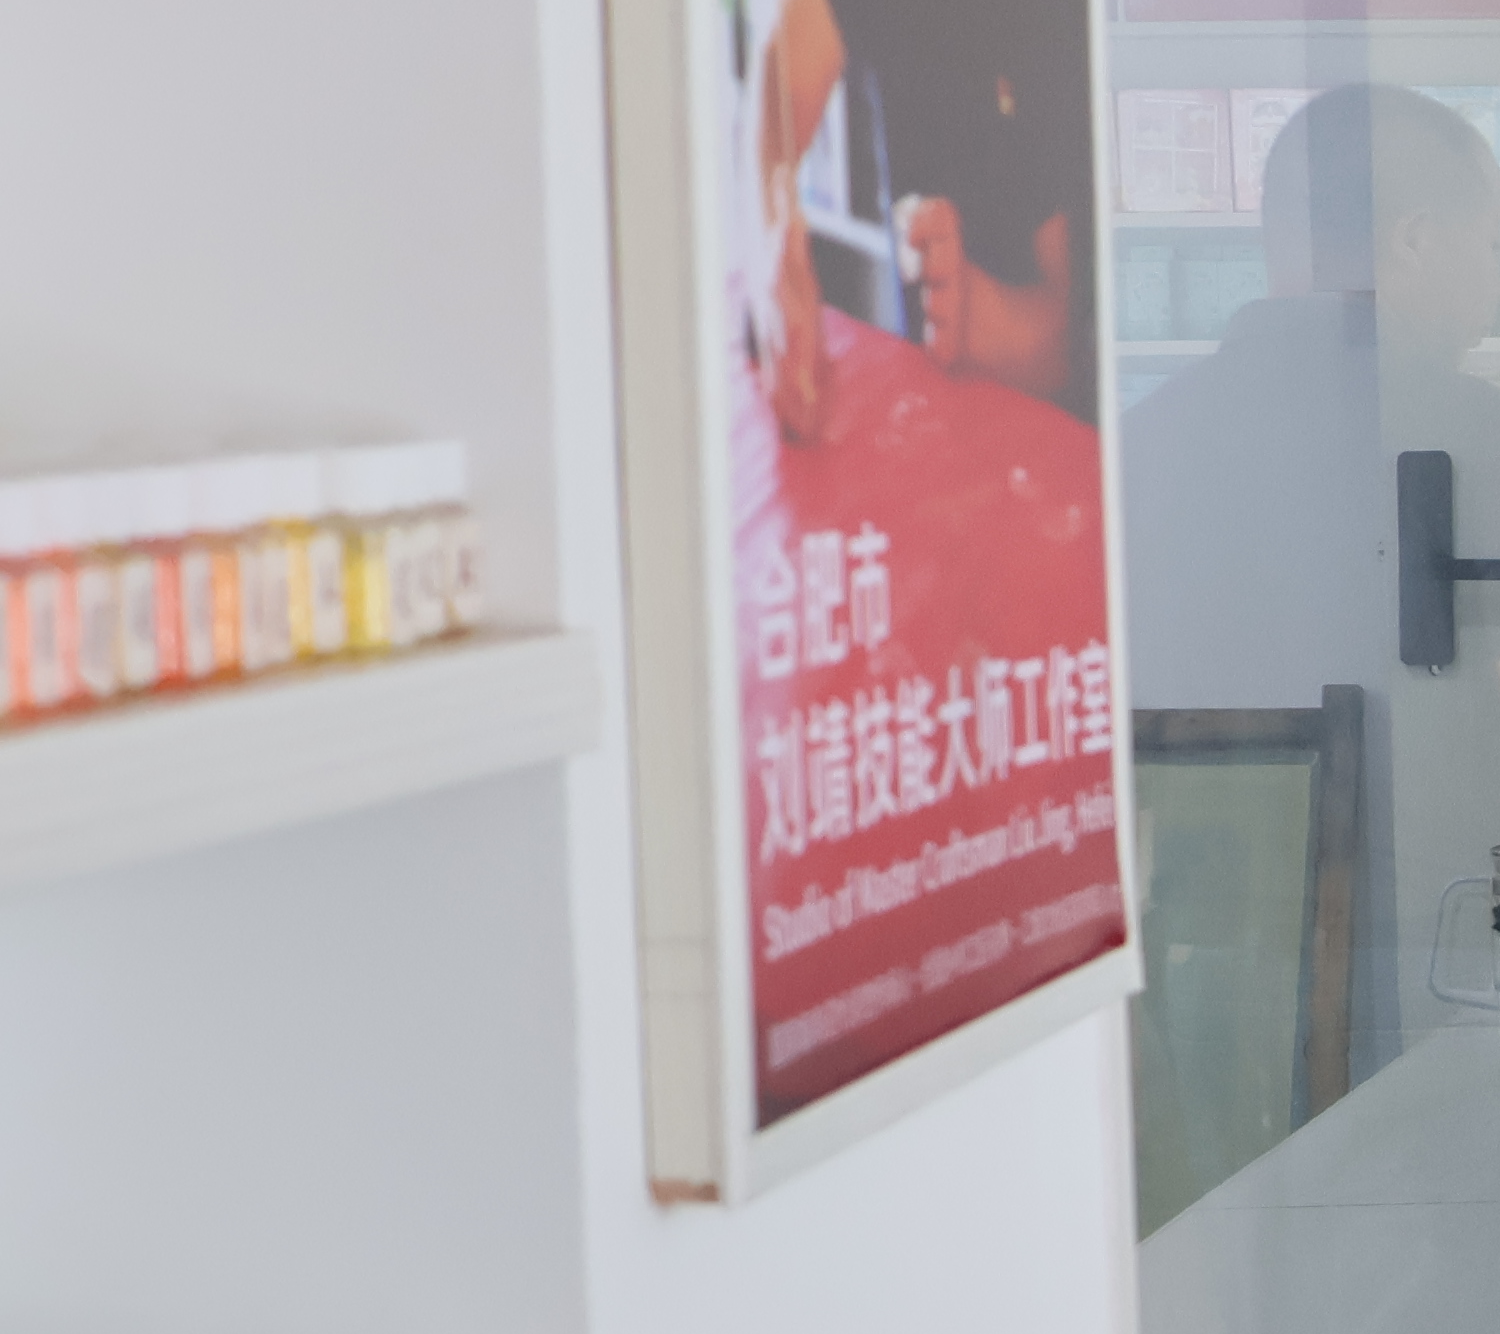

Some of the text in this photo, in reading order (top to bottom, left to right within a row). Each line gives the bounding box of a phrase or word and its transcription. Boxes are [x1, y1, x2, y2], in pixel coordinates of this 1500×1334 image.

[756, 522, 893, 680] 合肥市
[756, 638, 1113, 863] 刘靖技能大师工作室
